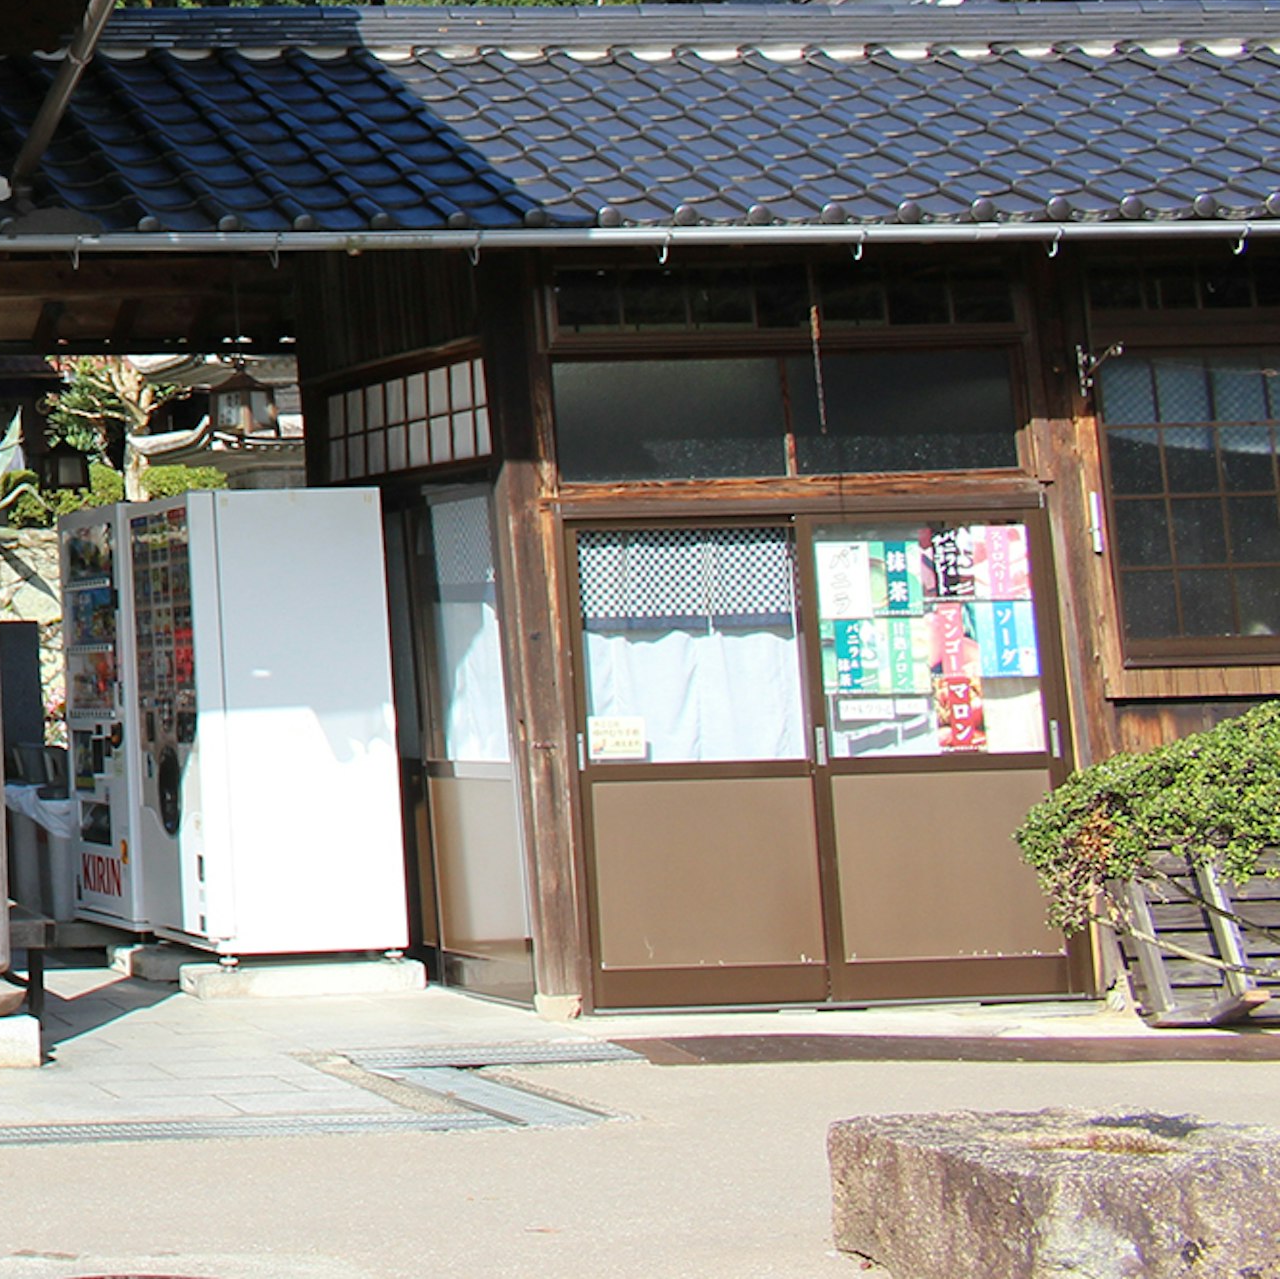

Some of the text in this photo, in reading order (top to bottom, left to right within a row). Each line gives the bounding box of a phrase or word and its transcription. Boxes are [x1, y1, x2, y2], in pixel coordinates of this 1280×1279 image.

[828, 548, 852, 616] バニラ
[886, 549, 910, 603] 抹茶
[990, 531, 1006, 593] ストロベリー
[940, 609, 961, 671] マンゴー
[996, 607, 1018, 667] ソーダ
[948, 683, 971, 741] マロン
[82, 852, 122, 897] KIRIN
